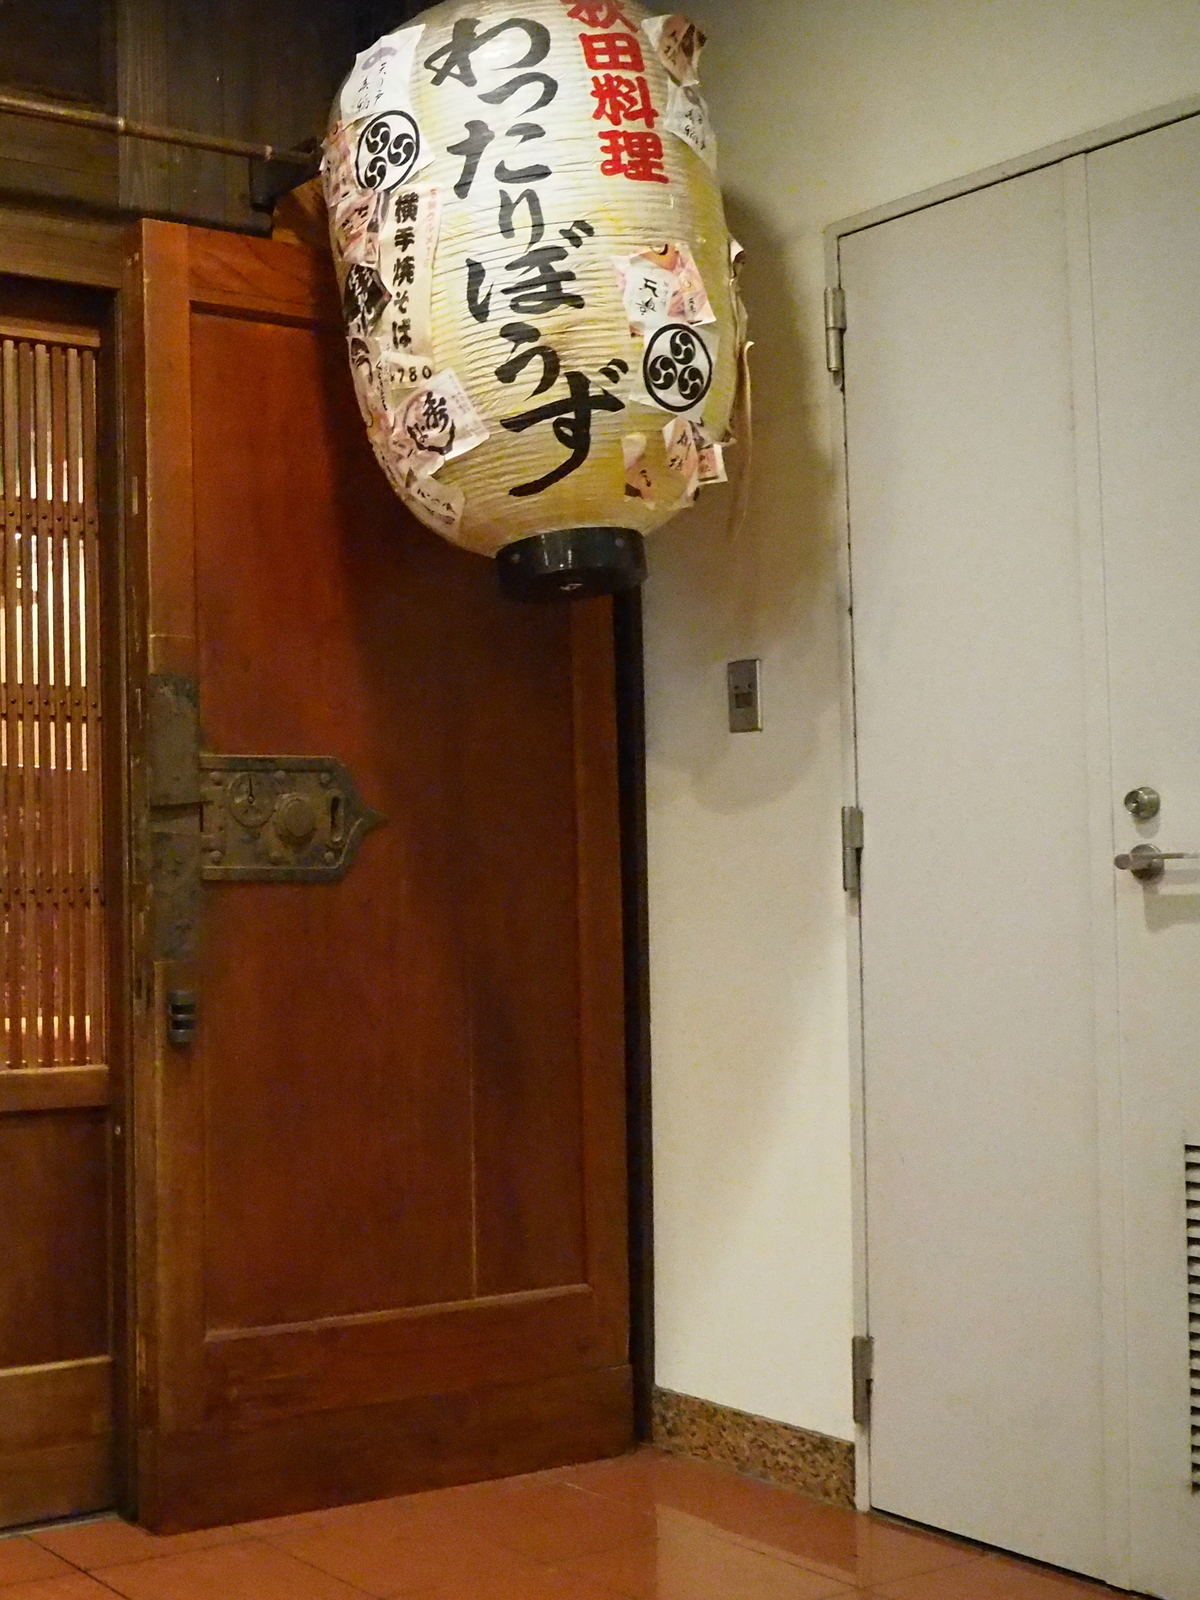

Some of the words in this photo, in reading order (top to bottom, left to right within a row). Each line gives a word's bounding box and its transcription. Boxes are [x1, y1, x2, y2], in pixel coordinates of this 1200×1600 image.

[424, 18, 629, 497] わったりぼうず
